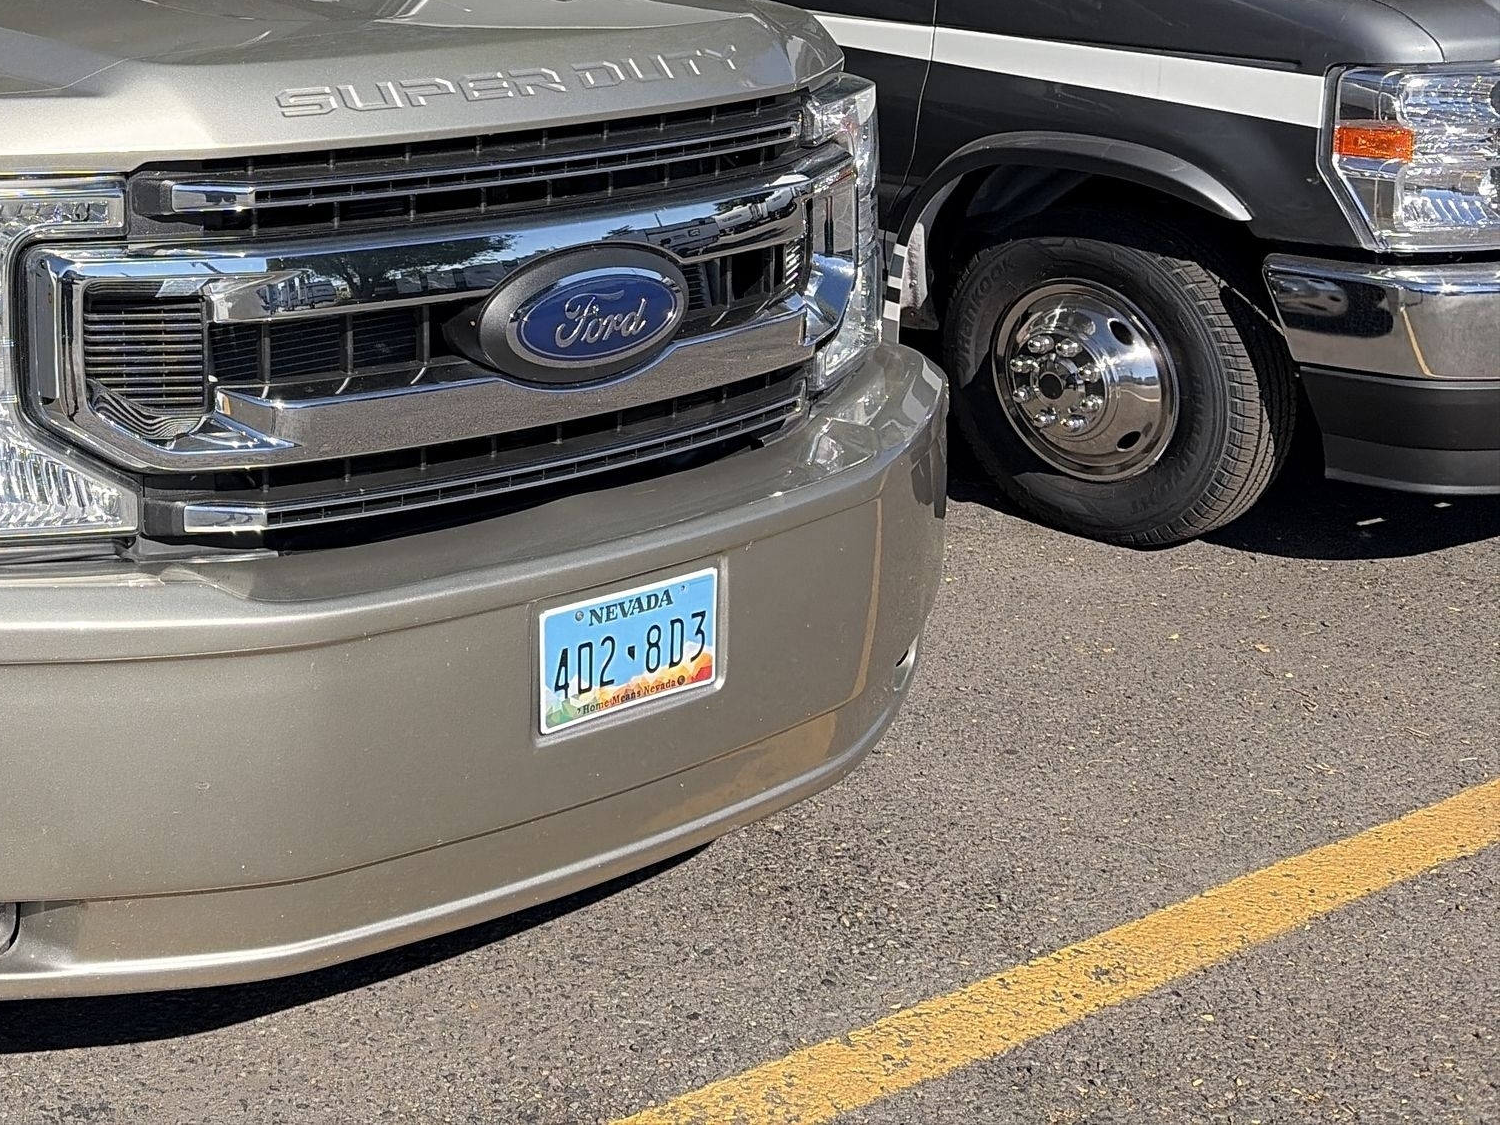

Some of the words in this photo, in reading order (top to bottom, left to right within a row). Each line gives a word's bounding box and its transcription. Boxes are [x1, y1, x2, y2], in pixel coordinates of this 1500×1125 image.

[275, 68, 567, 118] SUPER
[571, 44, 737, 90] DUTY
[555, 289, 648, 348] Ford
[588, 589, 674, 626] NEVADA
[582, 700, 609, 715] Home
[612, 689, 641, 705] Means
[643, 679, 676, 695] Nevada
